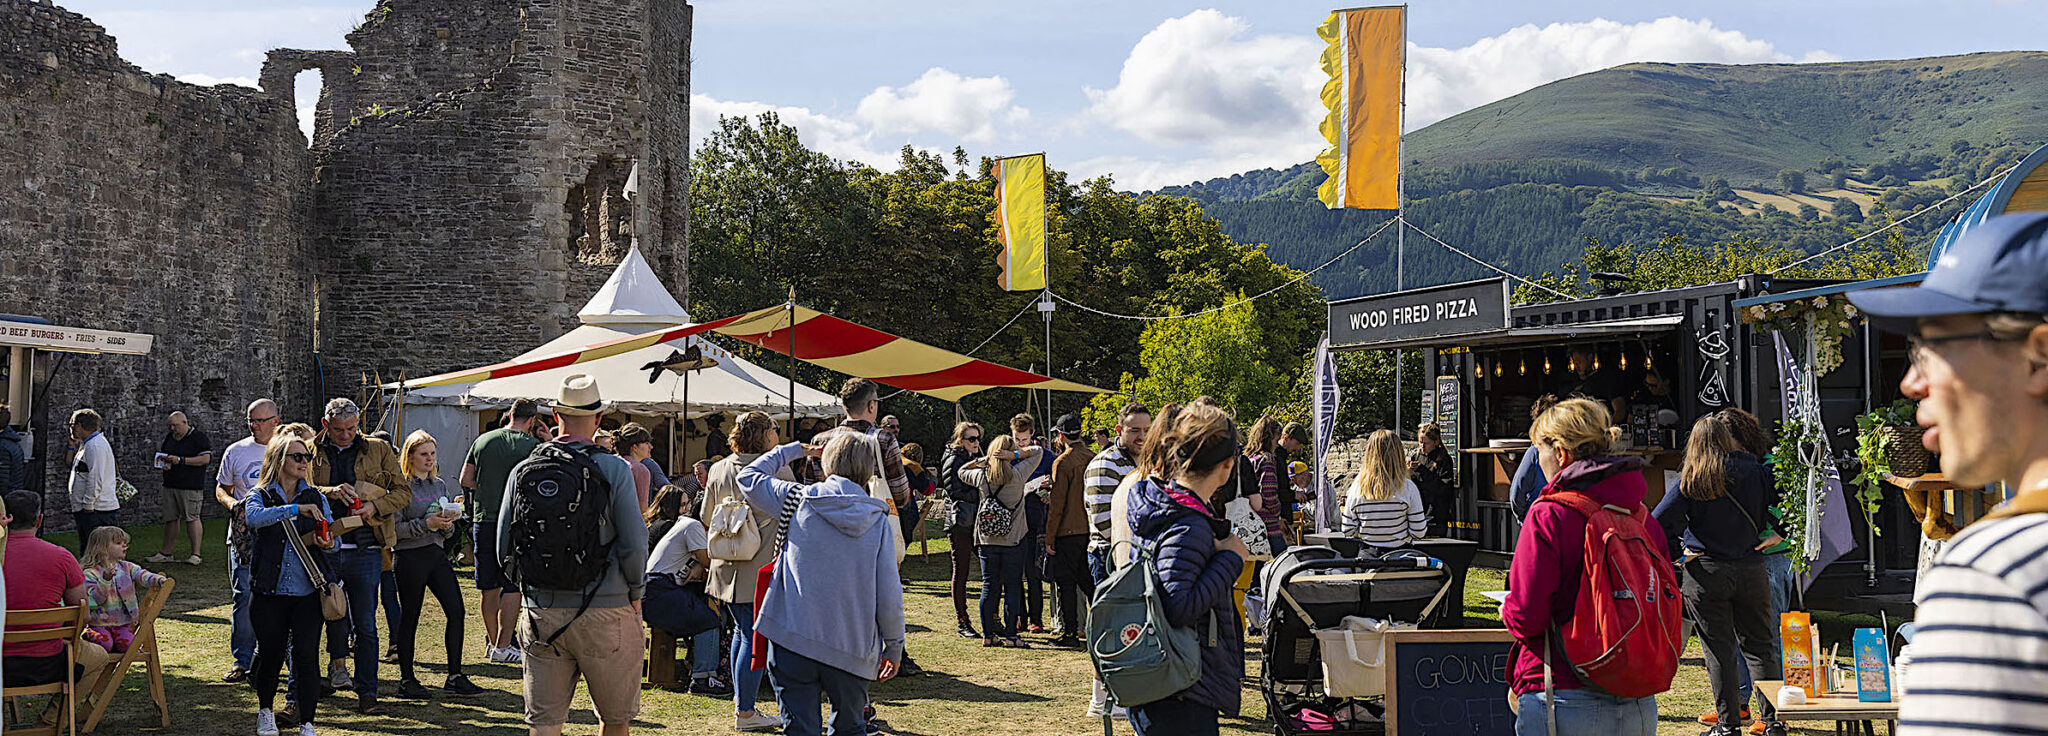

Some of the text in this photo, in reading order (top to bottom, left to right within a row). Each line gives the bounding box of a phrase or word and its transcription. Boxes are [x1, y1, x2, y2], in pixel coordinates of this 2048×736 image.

[1349, 298, 1478, 331] WOOD FIRED PIZZA
[9, 327, 29, 337] BEEF
[31, 329, 65, 341] BURGERS
[75, 333, 96, 343] FRIES
[107, 336, 126, 346] SIDES
[1411, 695, 1512, 730] COFF
